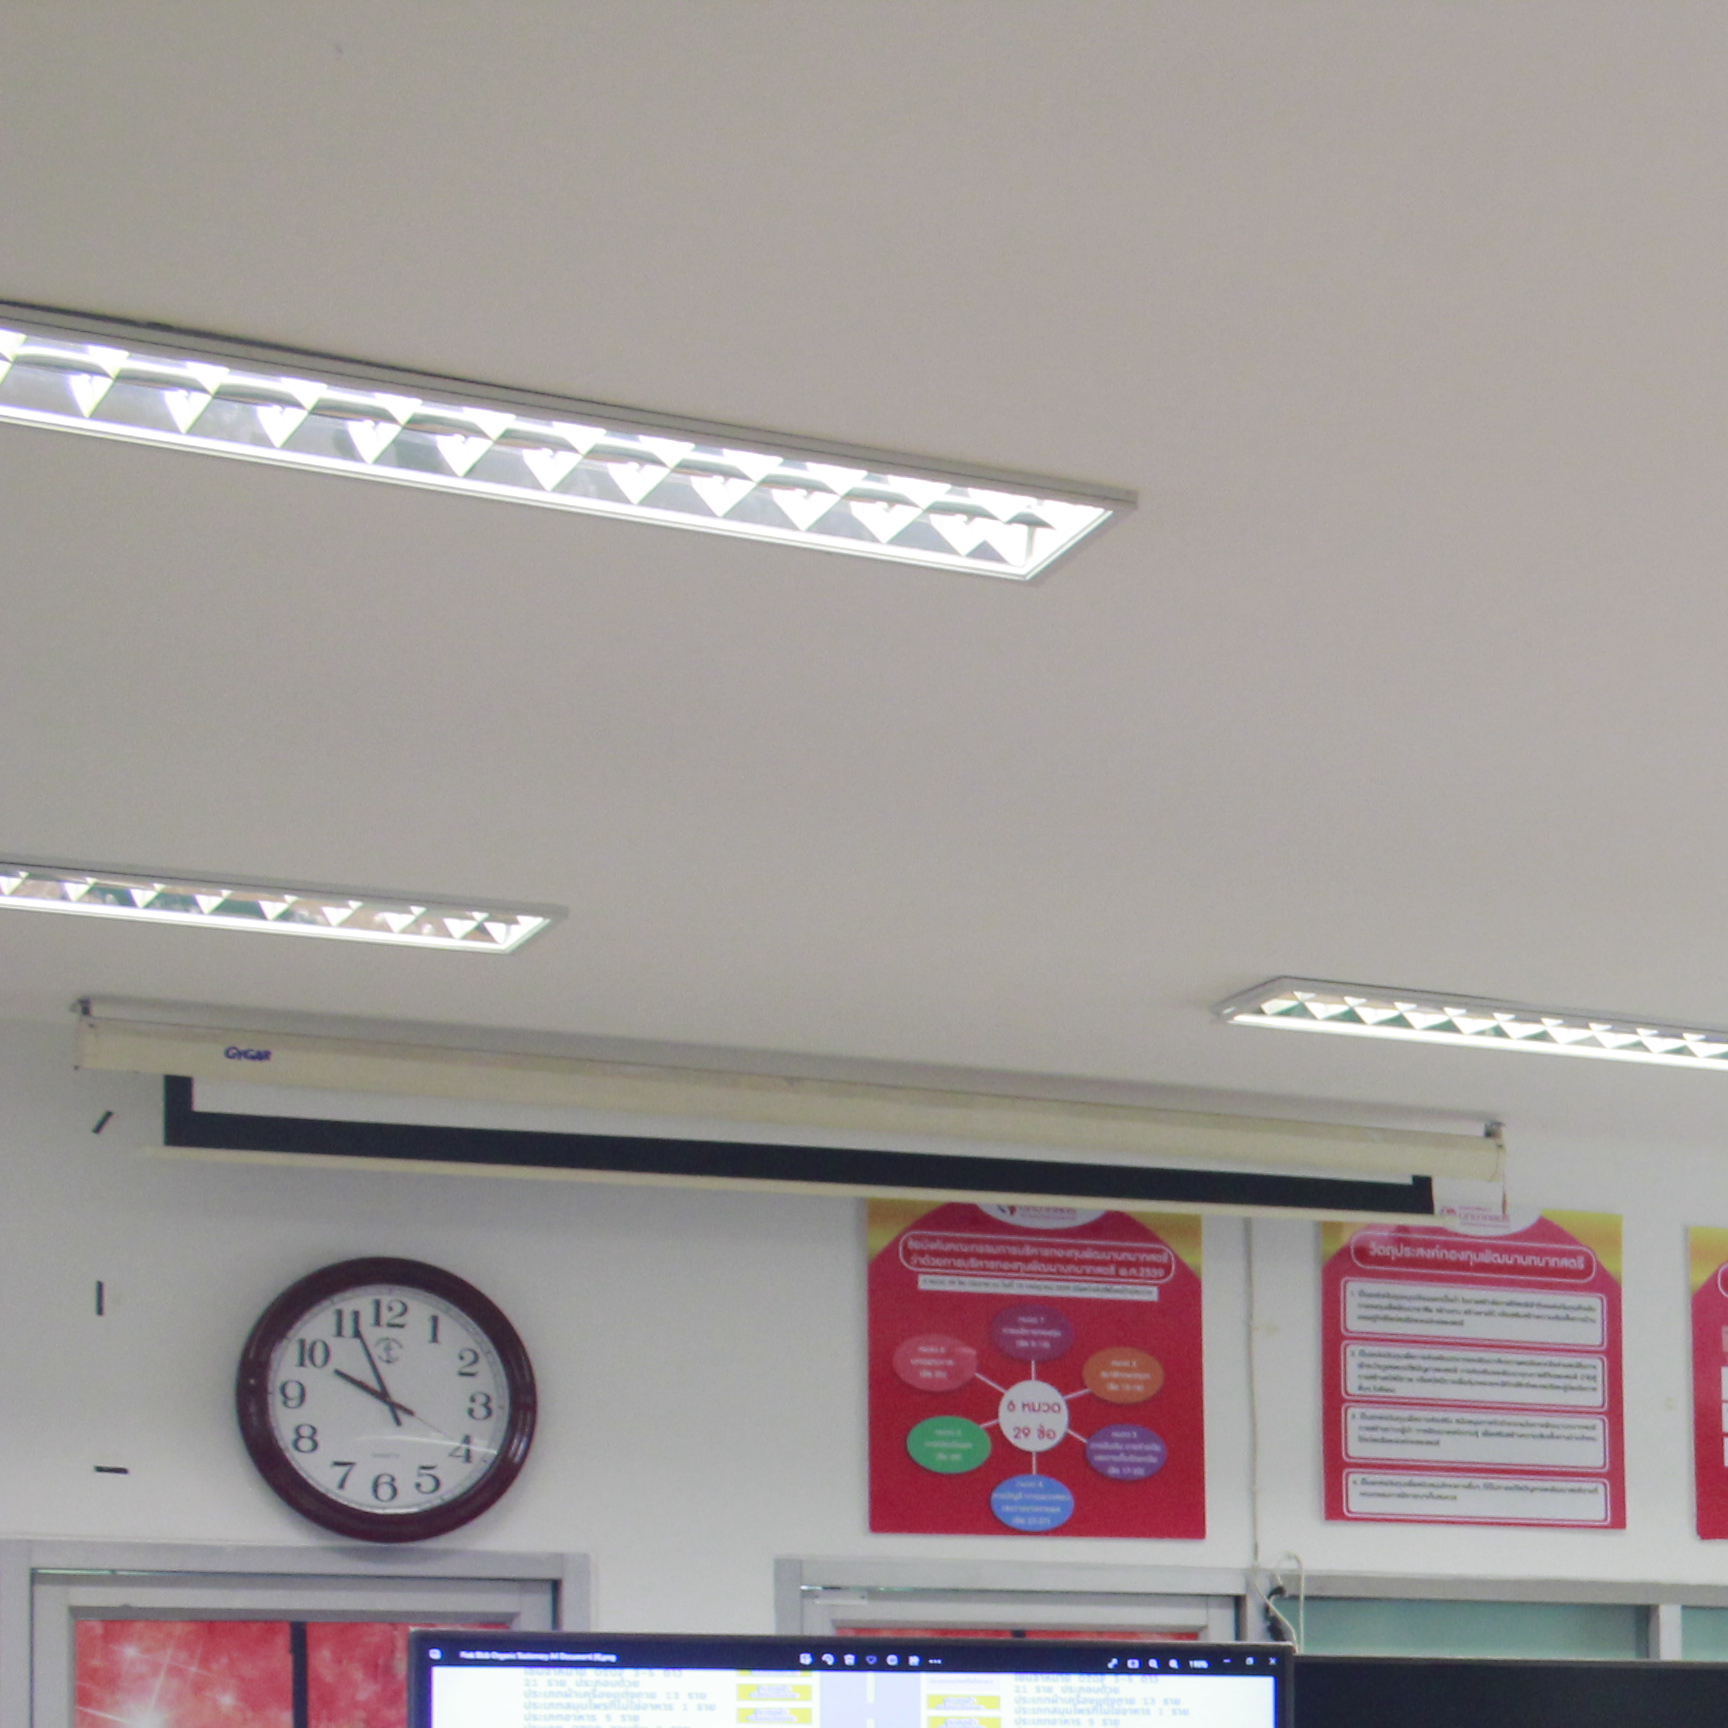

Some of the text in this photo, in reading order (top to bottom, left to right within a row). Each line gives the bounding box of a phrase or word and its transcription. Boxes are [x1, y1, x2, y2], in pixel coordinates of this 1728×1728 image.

[332, 1308, 361, 1339] 11
[370, 1298, 408, 1329] 12
[427, 1314, 441, 1344] 1
[295, 1338, 331, 1369] 10
[457, 1348, 480, 1378] 2
[279, 1380, 307, 1409] 9
[467, 1391, 492, 1421] 3
[1006, 1399, 1061, 1414] 6 หมวด
[292, 1423, 318, 1454] 8
[1012, 1422, 1057, 1440] 29 ข้อ
[448, 1434, 473, 1464] 4
[331, 1460, 356, 1491] 7
[371, 1472, 398, 1503] 6
[414, 1464, 441, 1494] 5
